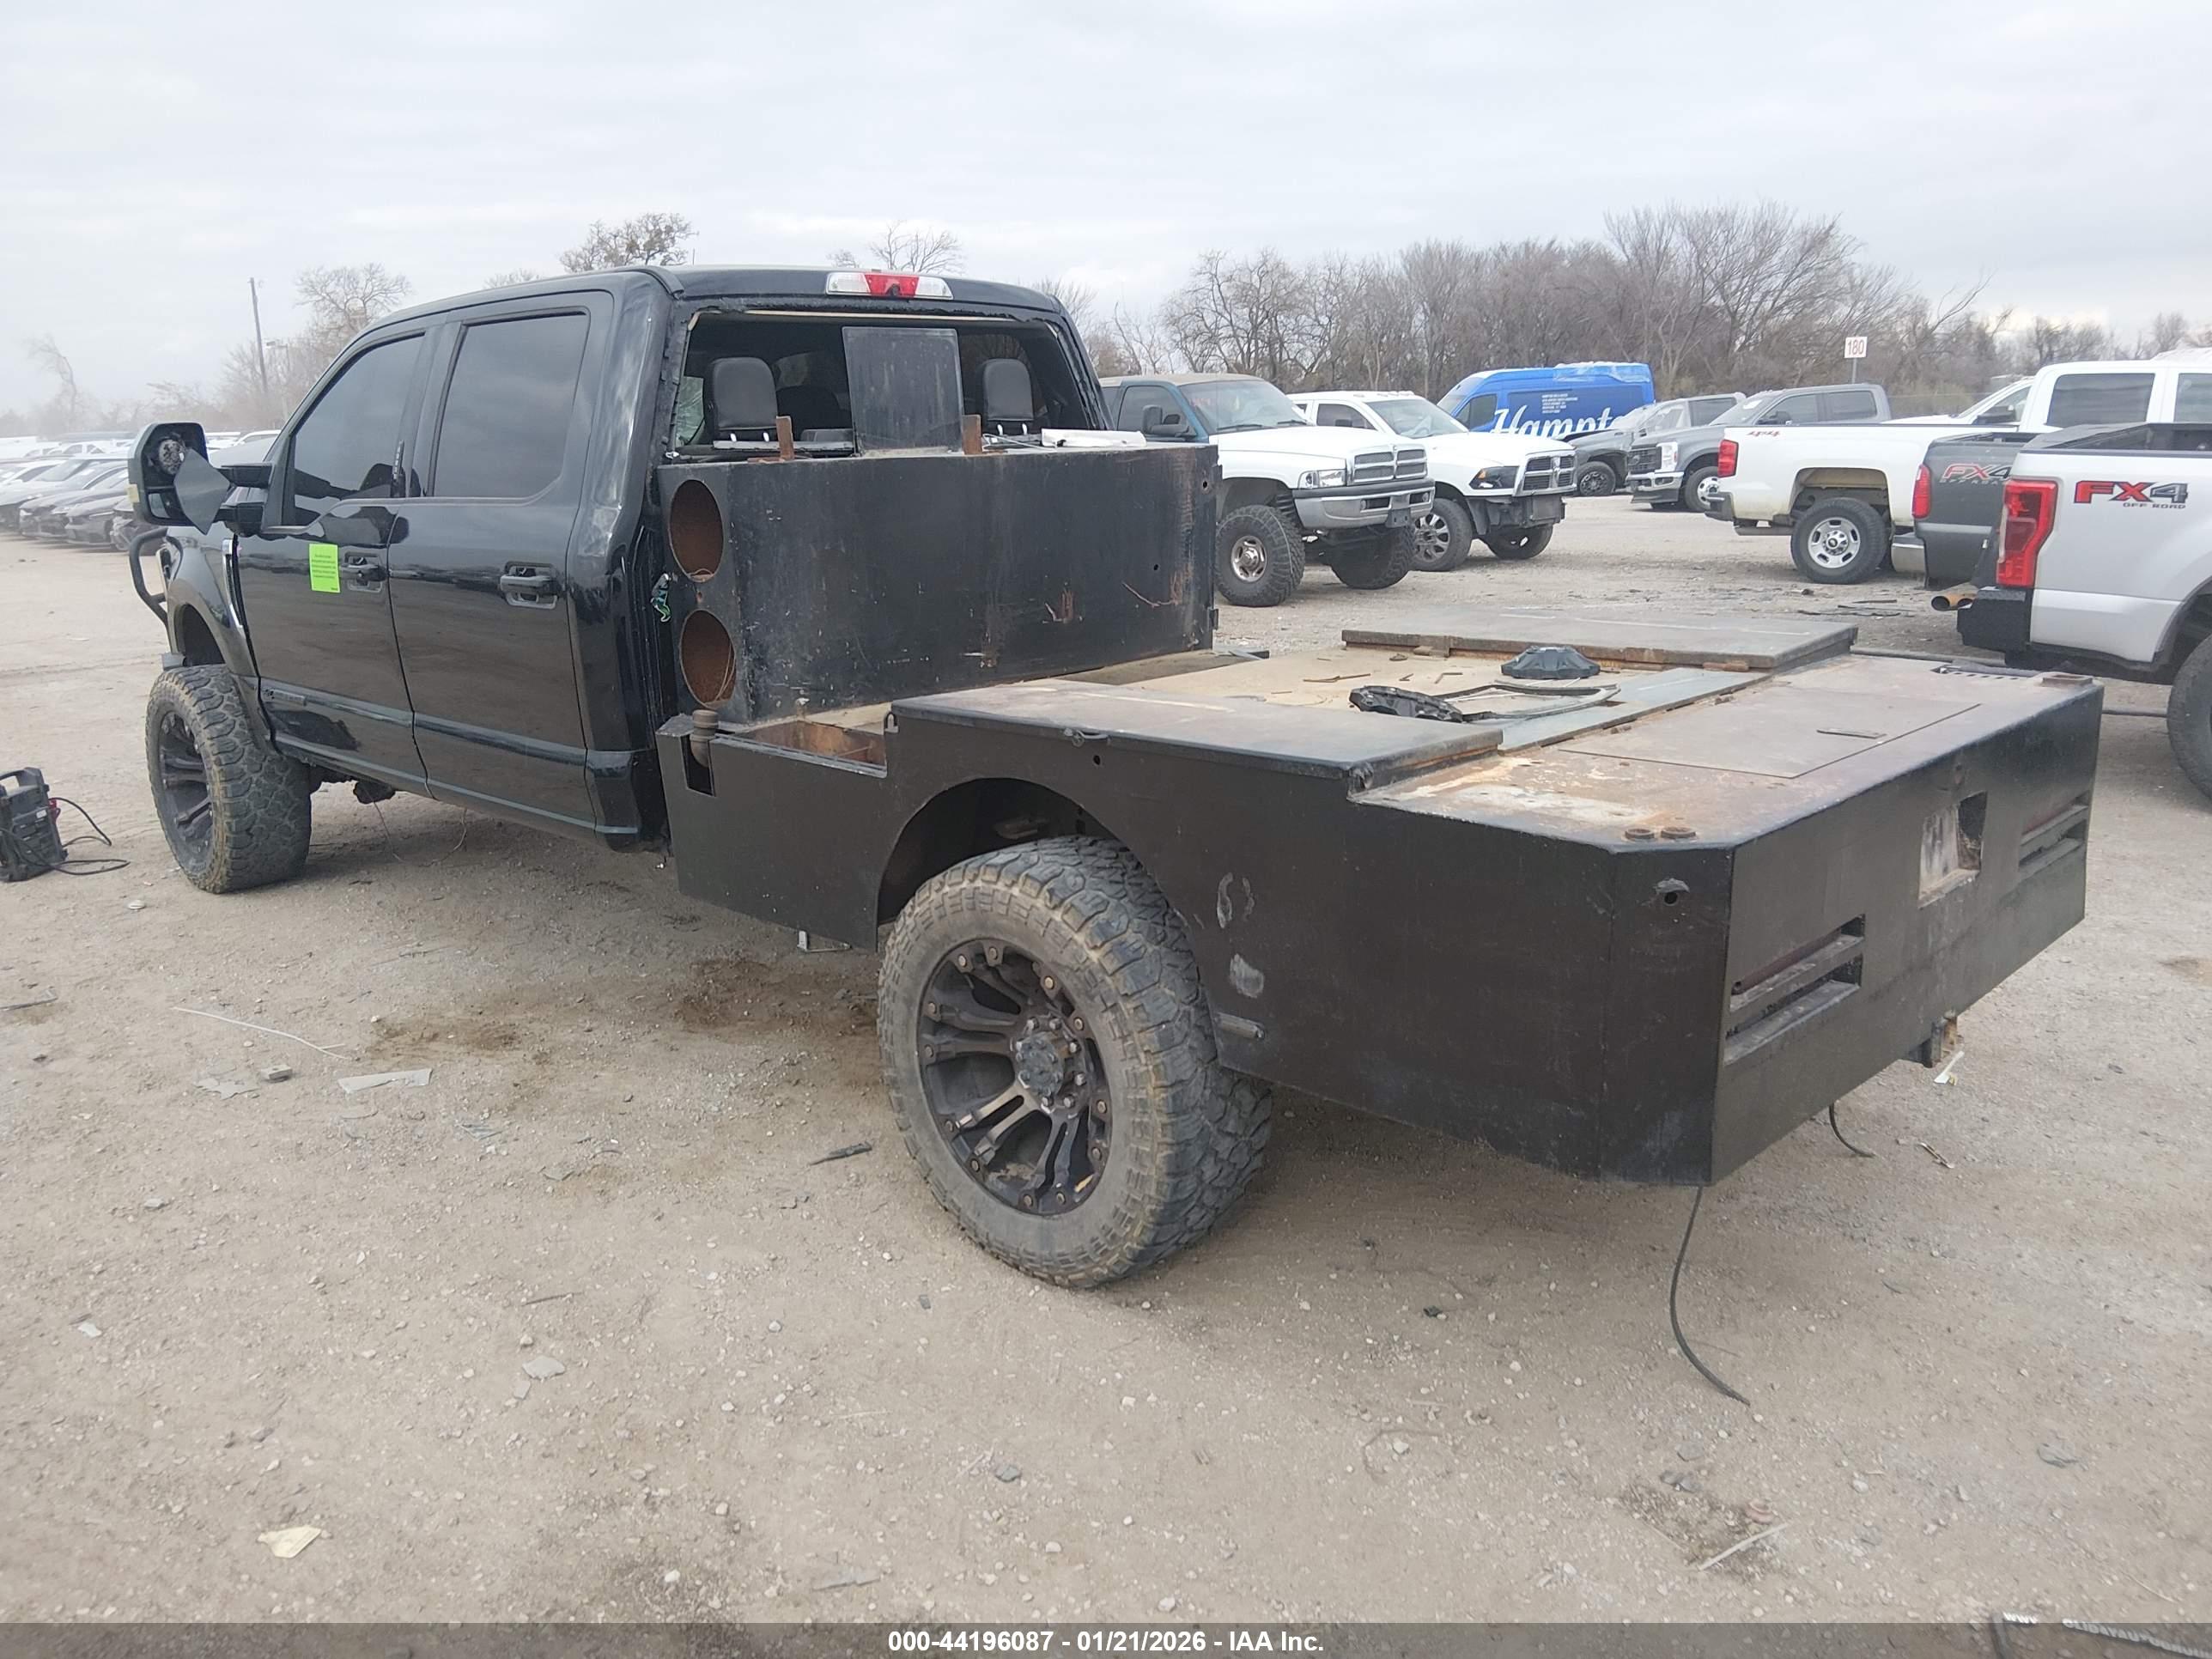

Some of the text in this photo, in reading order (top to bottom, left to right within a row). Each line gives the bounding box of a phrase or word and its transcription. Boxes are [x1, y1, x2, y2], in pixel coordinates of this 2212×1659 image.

[1848, 339, 1865, 355] 180
[1490, 404, 1624, 440] Hampt
[1942, 464, 2012, 480] FX4
[2074, 480, 2188, 504] FX4
